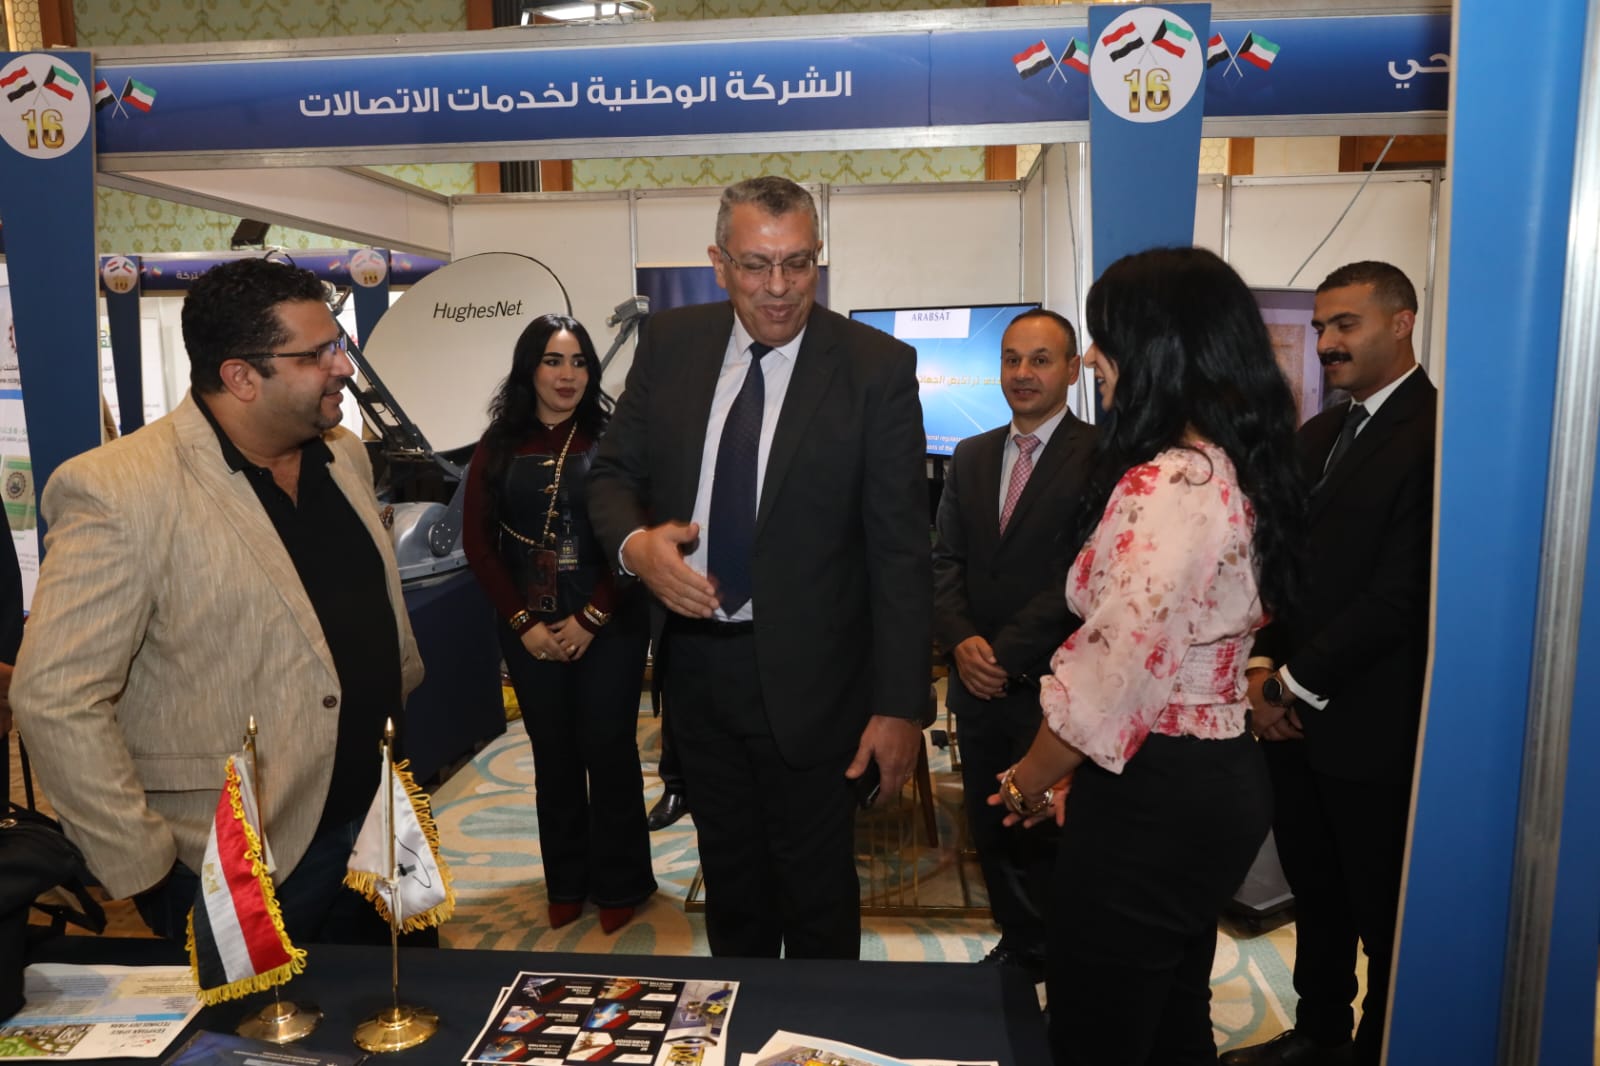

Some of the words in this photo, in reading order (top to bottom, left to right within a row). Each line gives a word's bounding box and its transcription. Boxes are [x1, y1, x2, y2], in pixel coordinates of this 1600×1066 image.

[447, 82, 578, 112] لخدمات
[587, 76, 717, 112] الوطنية
[725, 65, 853, 106] الشركة
[1123, 68, 1171, 113] 16
[299, 87, 440, 118] الاتصالات
[21, 108, 64, 150] 16
[433, 299, 523, 323] HughesNet
[911, 311, 951, 322] ARABSAT
